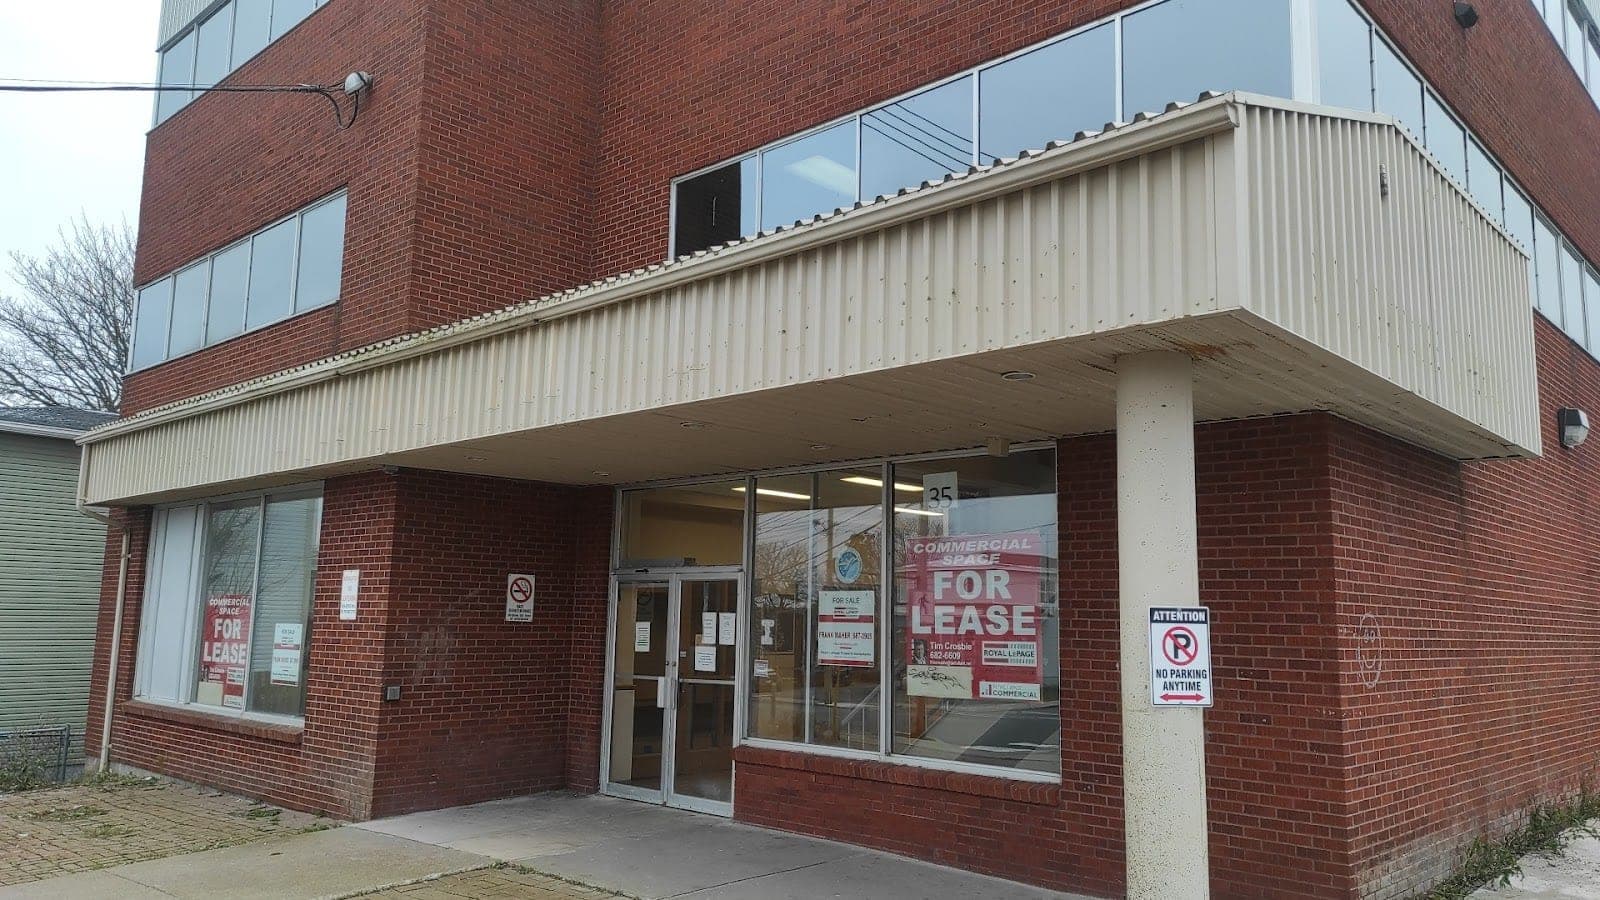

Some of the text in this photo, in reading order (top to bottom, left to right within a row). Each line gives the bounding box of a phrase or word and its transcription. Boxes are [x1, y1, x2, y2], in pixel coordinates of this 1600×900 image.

[928, 486, 953, 509] 35
[913, 538, 1033, 554] COMMERCIAL
[942, 553, 1001, 566] SPACE
[933, 569, 1012, 600] FOR
[209, 598, 250, 607] COMMERCIAL
[218, 607, 240, 615] SPACE
[1153, 610, 1206, 622] ATTENTION
[911, 605, 1037, 636] LEASE
[213, 618, 242, 640] FOR
[929, 641, 973, 651] Tim Crosbie
[203, 641, 247, 664] LEASE
[983, 649, 1008, 657] ROYAL
[1156, 668, 1207, 679] NO PARKING
[1163, 681, 1202, 691] ANYTIME
[993, 689, 1038, 698] COMMERCIAL
